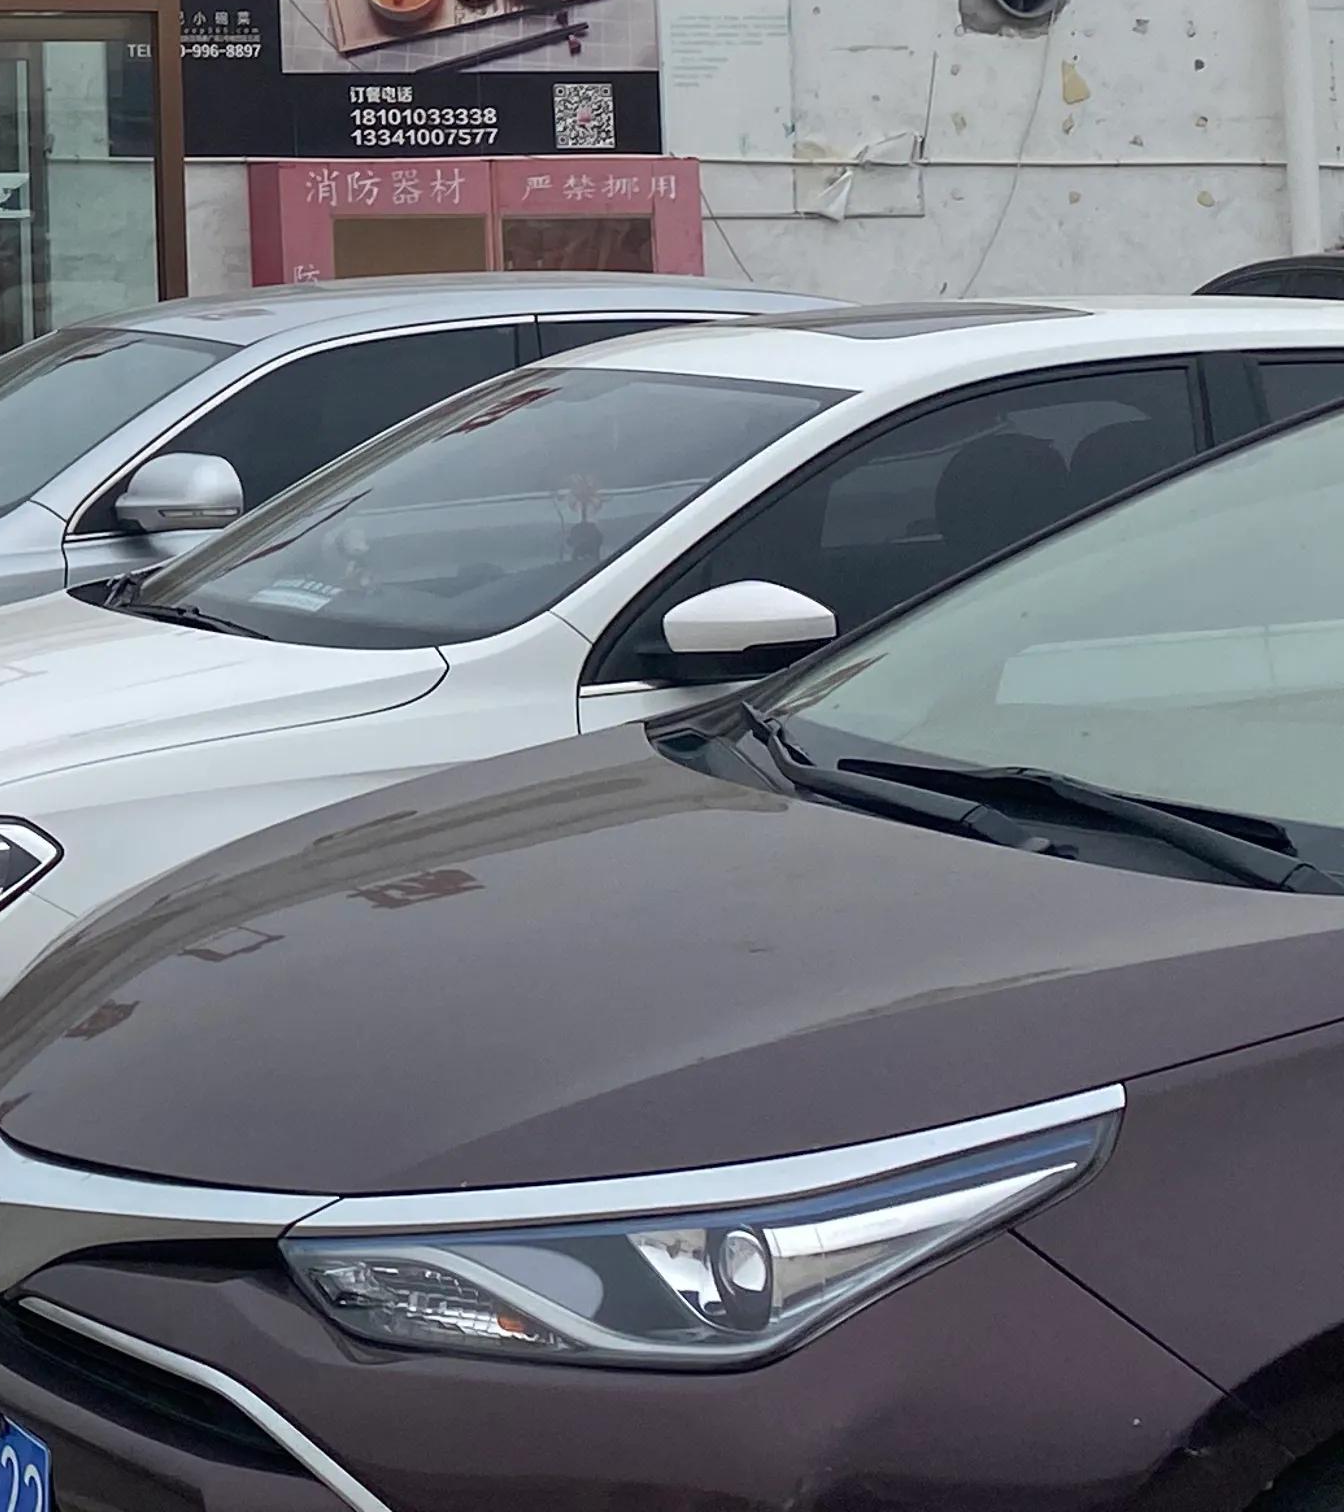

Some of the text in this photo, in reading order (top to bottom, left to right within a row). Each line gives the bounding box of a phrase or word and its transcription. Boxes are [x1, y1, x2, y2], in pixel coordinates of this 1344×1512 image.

[350, 86, 413, 103] 订餐电话
[350, 107, 497, 126] 18101033338
[350, 128, 498, 146] 13341007577
[305, 167, 677, 207] 消防器材 严禁挪用
